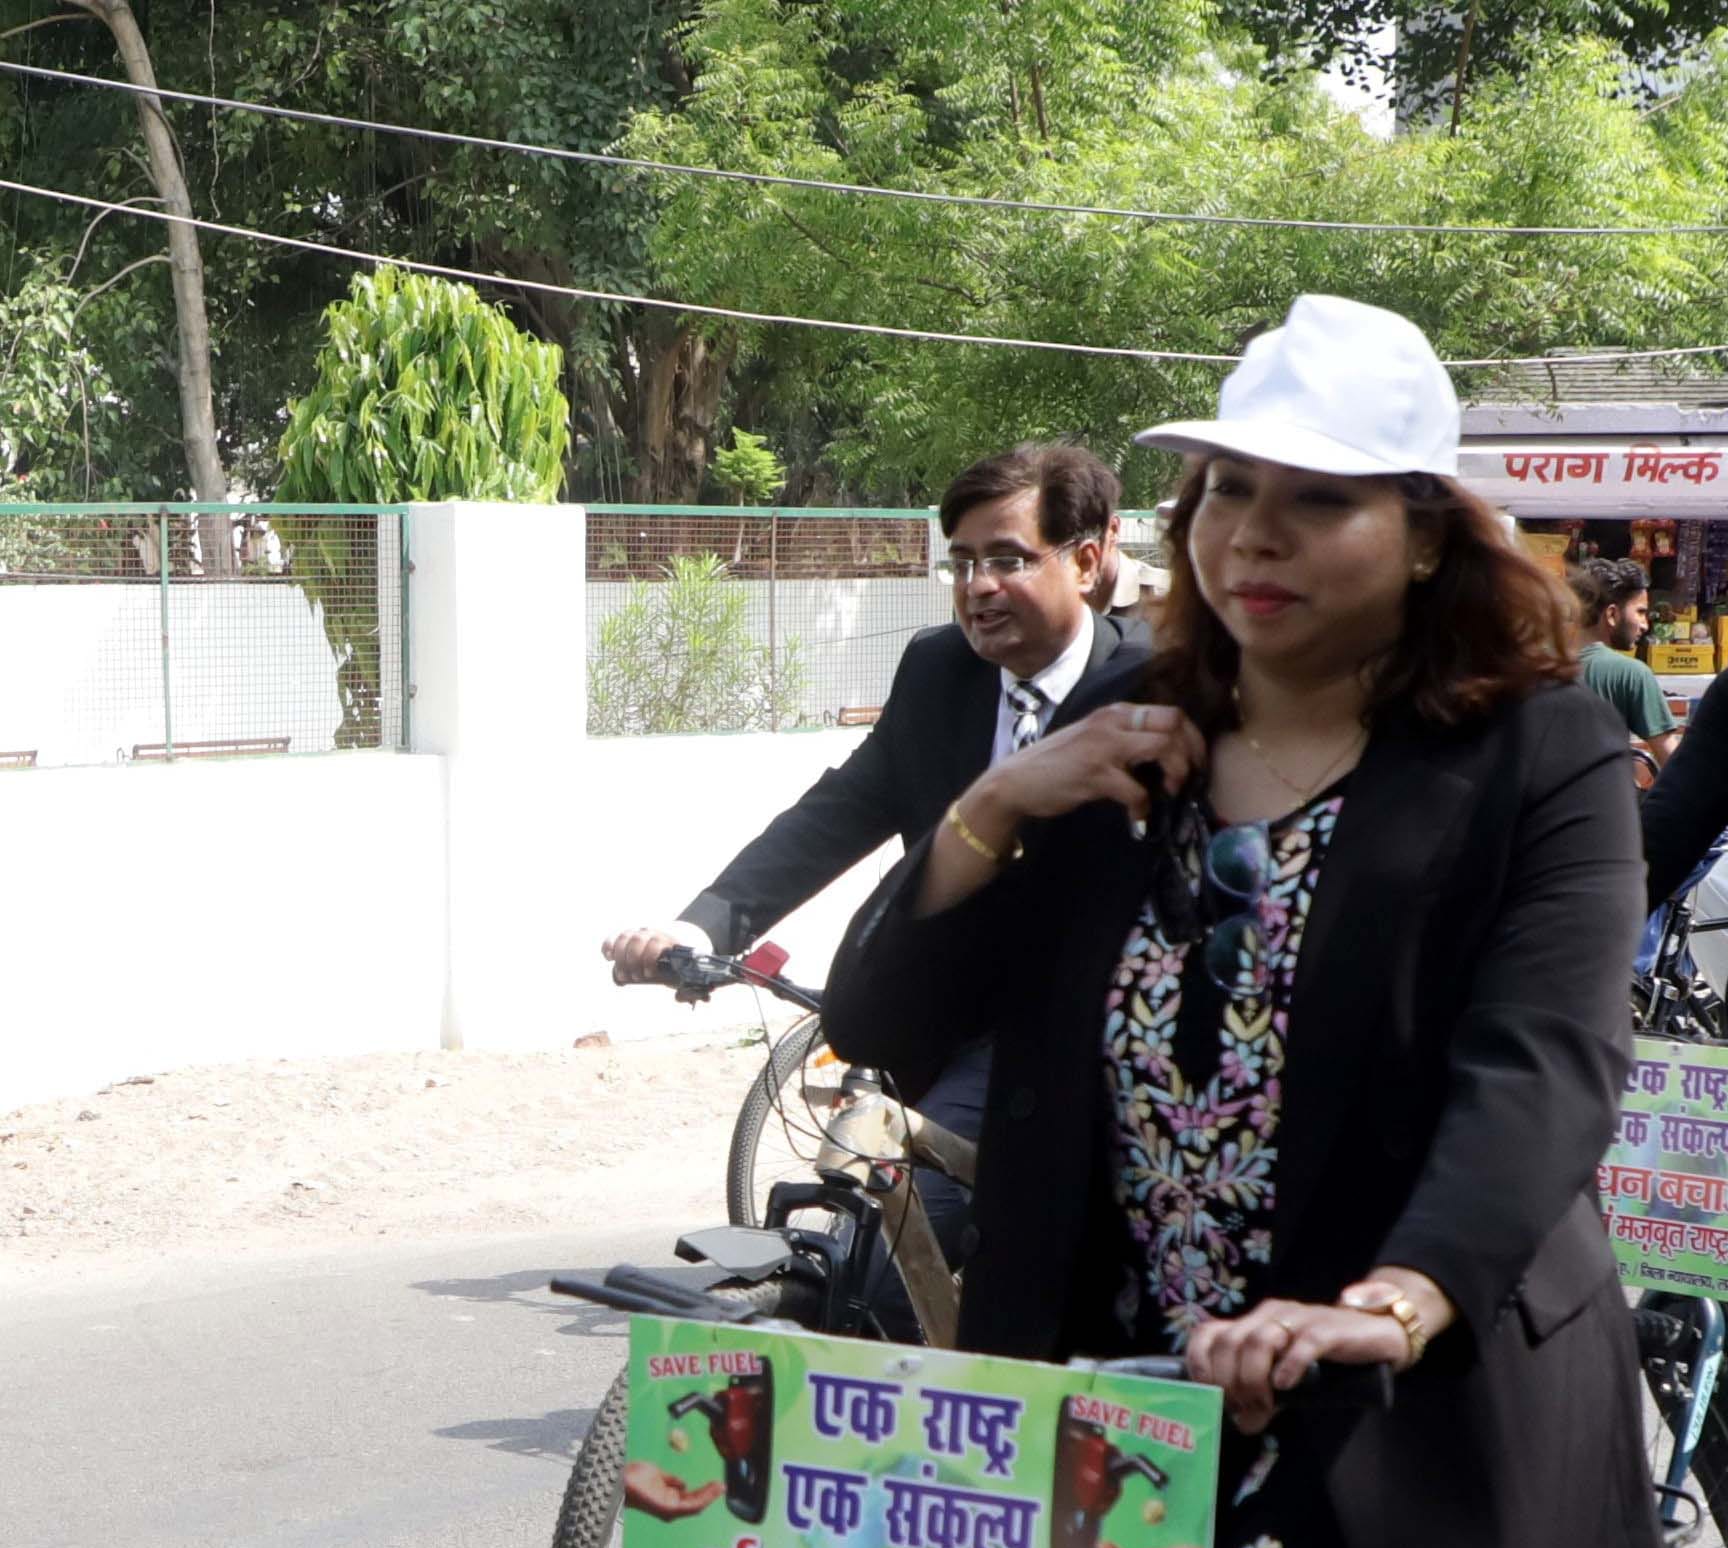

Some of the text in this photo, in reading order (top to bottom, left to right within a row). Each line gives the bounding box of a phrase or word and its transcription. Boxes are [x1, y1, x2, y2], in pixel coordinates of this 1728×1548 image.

[1504, 451, 1609, 484] पराग
[1622, 444, 1721, 485] मिल्क
[1597, 1164, 1654, 1206] धन
[649, 1352, 763, 1378] SAVE FUEL
[809, 1373, 1024, 1477] एक राष्ट्र
[1072, 1395, 1195, 1451] SAVE FUEL
[783, 1464, 868, 1535] एक
